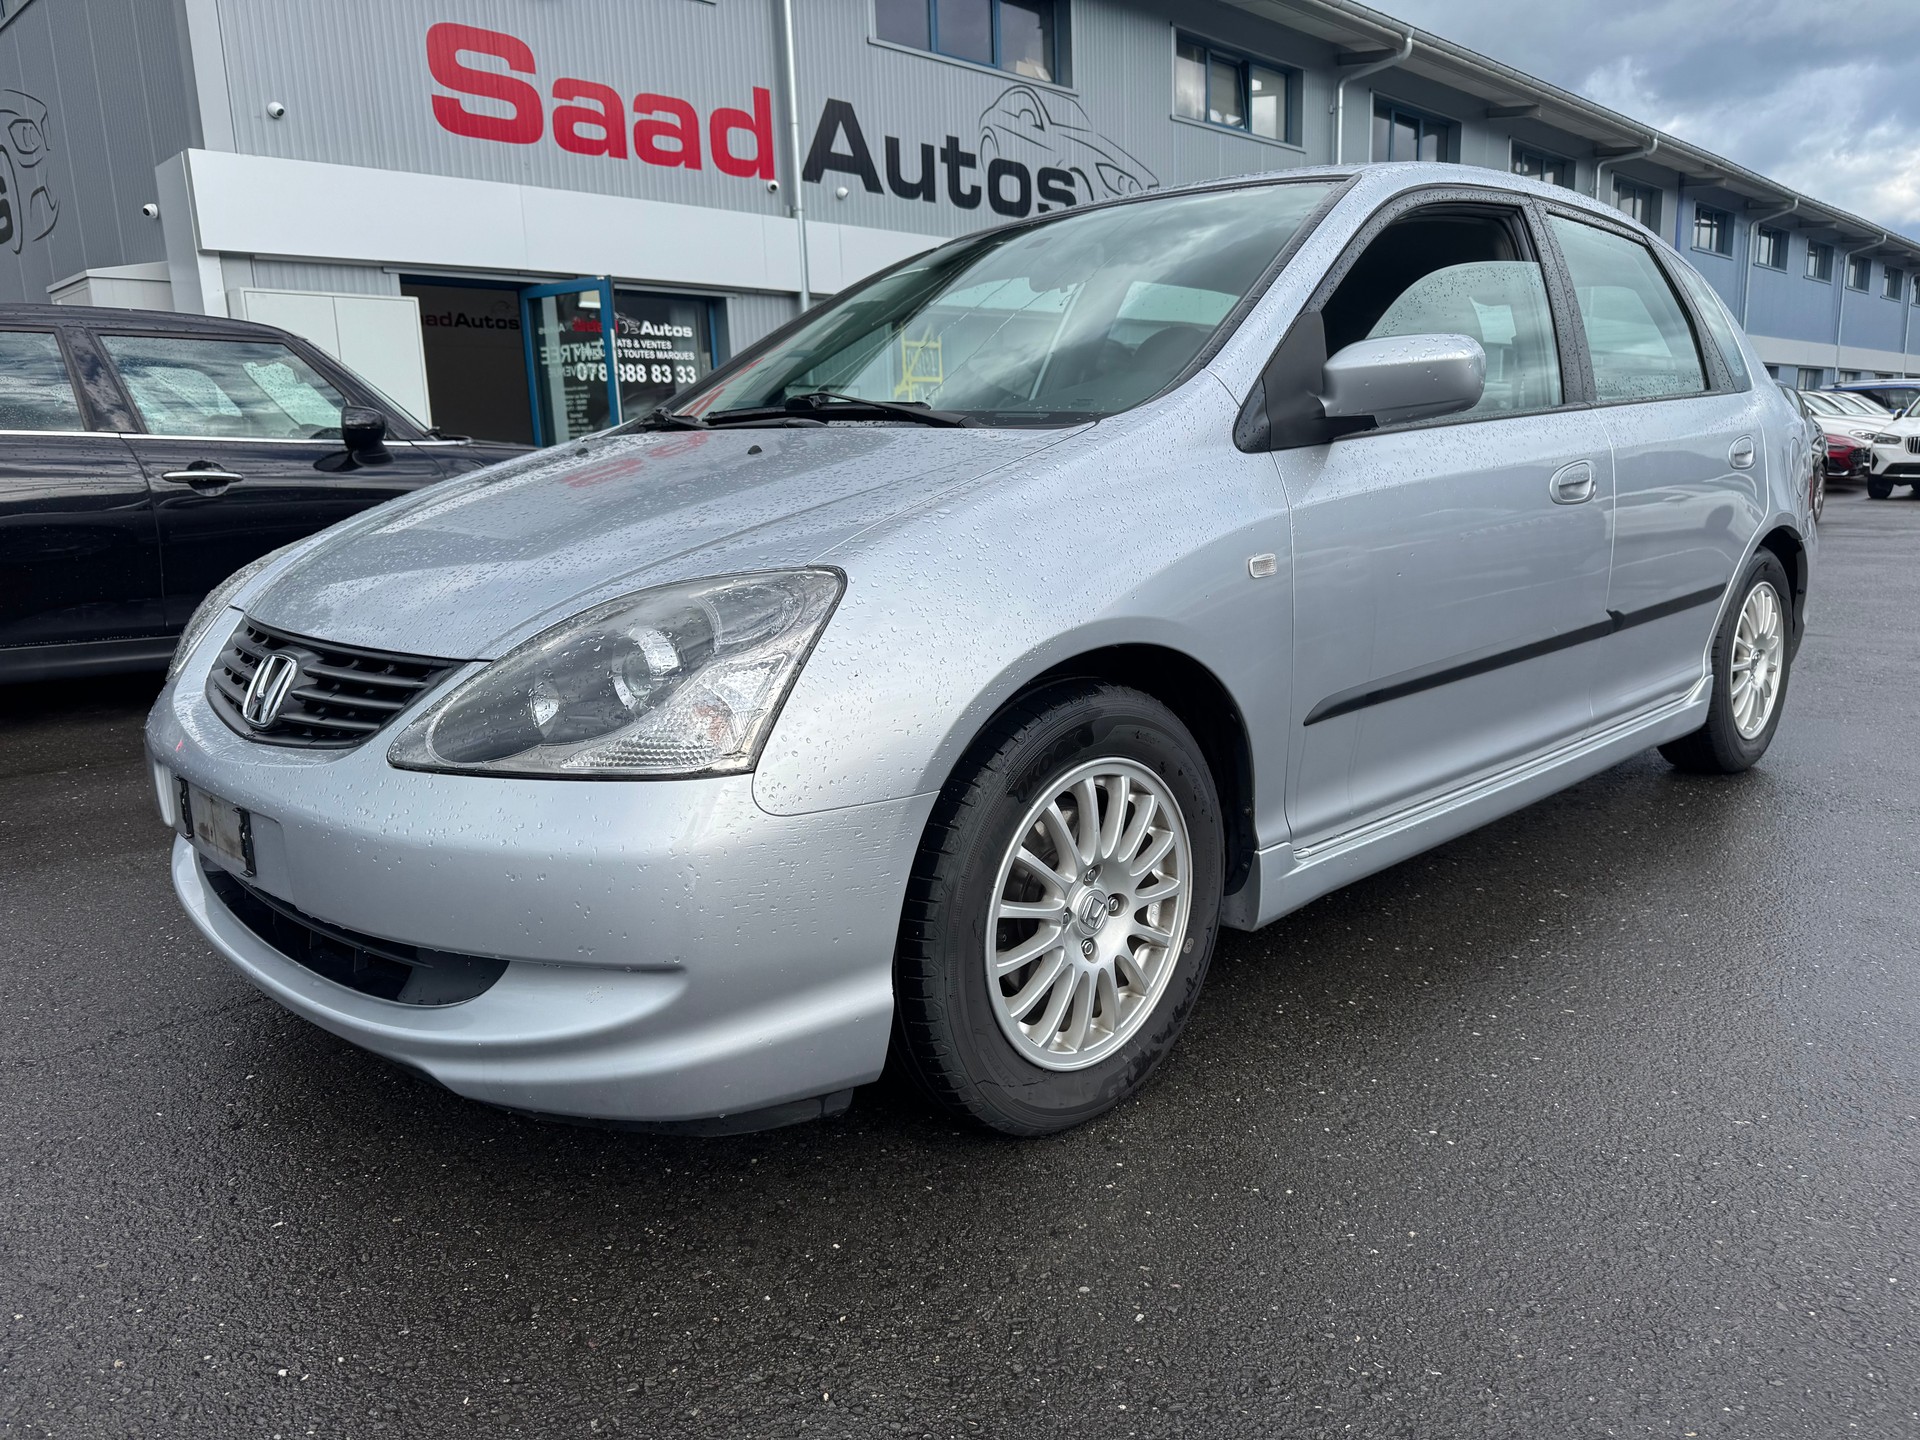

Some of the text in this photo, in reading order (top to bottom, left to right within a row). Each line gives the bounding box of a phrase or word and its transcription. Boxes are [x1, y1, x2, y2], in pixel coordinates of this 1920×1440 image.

[426, 22, 1077, 216] Saad Autos
[641, 320, 693, 337] Autos
[641, 340, 672, 350] VENTES
[624, 350, 656, 361] TOUTES
[657, 352, 695, 362] MARQUES
[651, 364, 673, 384] 83
[676, 365, 697, 385] 33
